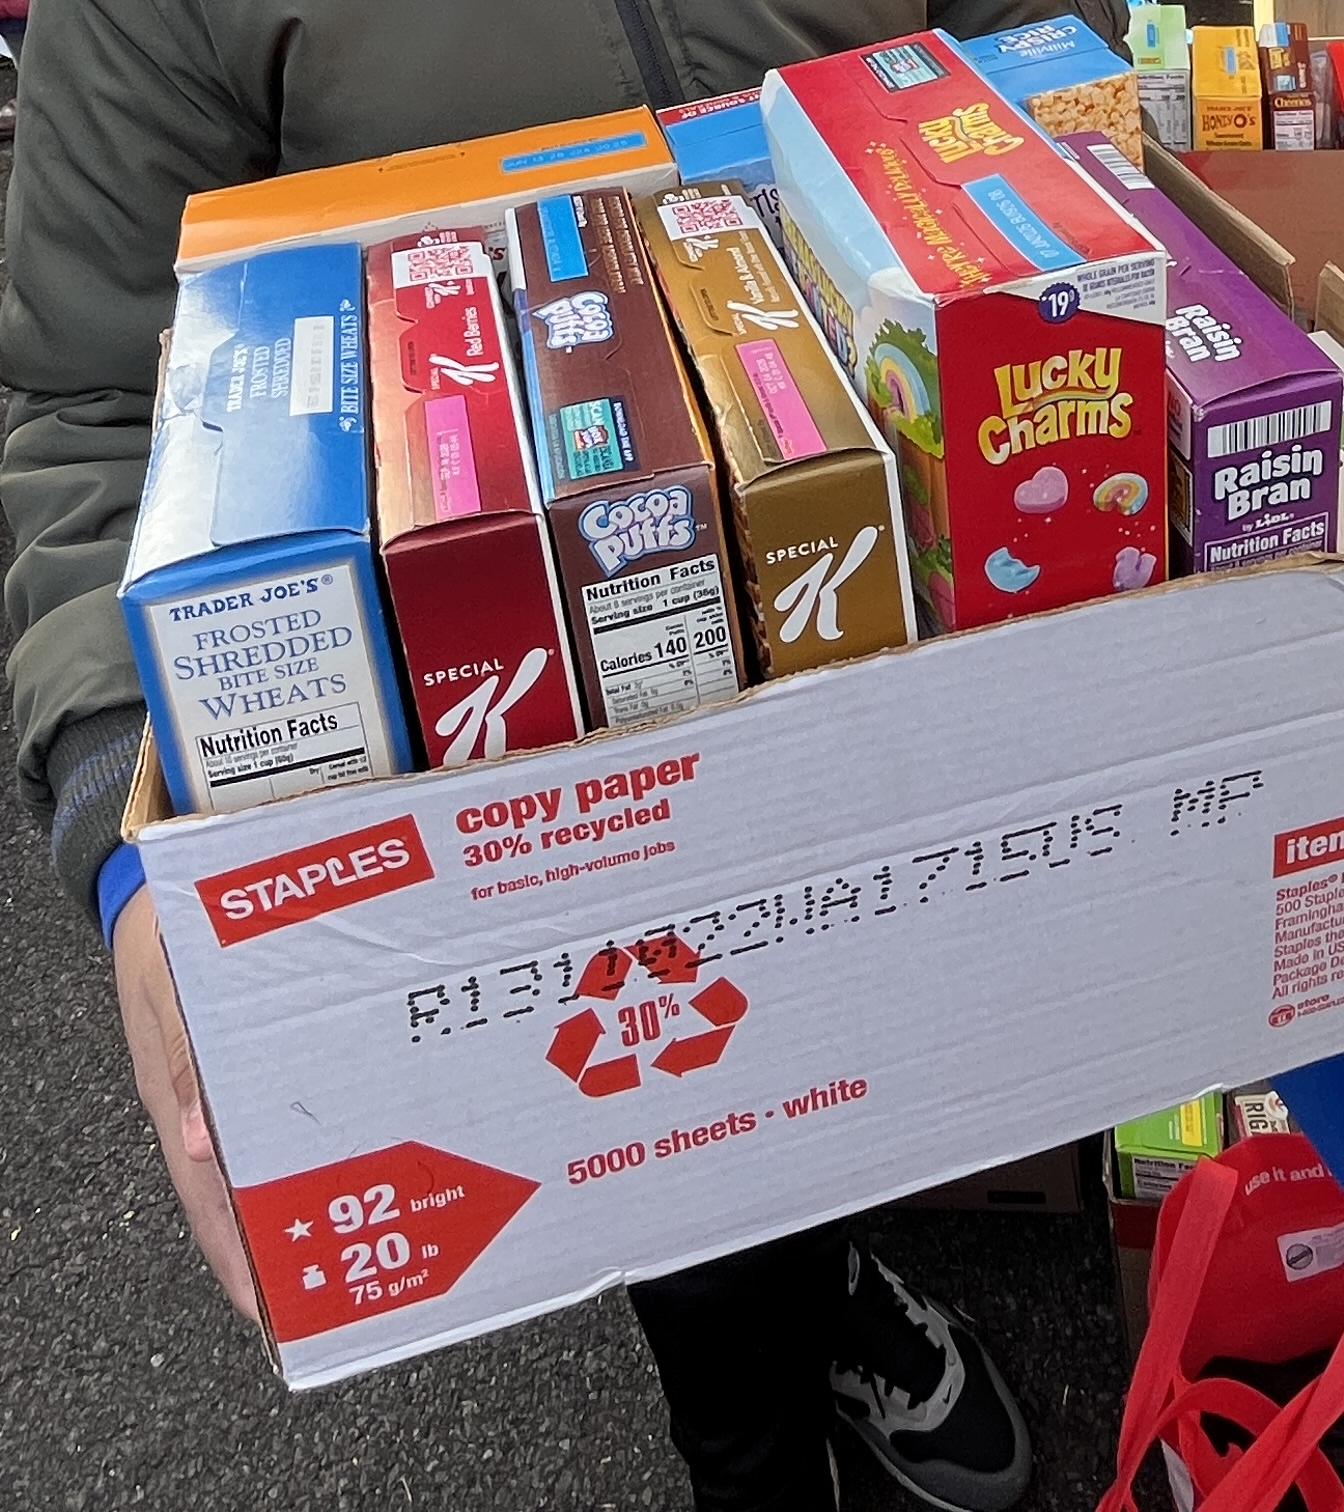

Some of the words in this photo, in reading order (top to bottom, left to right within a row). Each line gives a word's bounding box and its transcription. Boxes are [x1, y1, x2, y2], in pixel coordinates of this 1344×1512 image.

[997, 24, 1056, 45] RICE
[997, 27, 1078, 54] CRISPY
[1202, 114, 1233, 132] HONEY
[1274, 97, 1312, 108] Cheerios
[341, 314, 358, 360] WHEATS
[463, 306, 481, 336] Berries
[534, 298, 577, 346] Puffs
[572, 292, 610, 341] Cocoa
[1165, 315, 1211, 364] Bran
[1175, 303, 1243, 363] Raisin
[271, 338, 291, 398] SHREDDED
[466, 336, 484, 356] Red
[227, 375, 244, 412] TRADER
[250, 346, 270, 398] FROSTED
[341, 362, 359, 385] SIZE
[994, 347, 1122, 420] Lucky
[341, 388, 359, 414] BITE
[978, 392, 1134, 464] Charms
[1214, 444, 1324, 502] Raisin
[581, 488, 690, 539] Cocoa
[1228, 476, 1311, 523] Bran
[591, 516, 693, 577] Puffs
[766, 536, 839, 564] SPECIAL
[1209, 532, 1279, 565] Nutrition
[1282, 519, 1325, 544] Facts
[586, 573, 661, 601] Nutrition
[670, 559, 715, 581] Facts
[774, 526, 878, 643] K
[169, 593, 254, 622] TRADER
[193, 609, 321, 651] FROSTED
[591, 610, 630, 625] Serving
[633, 603, 653, 617] size
[663, 598, 668, 608] 1
[672, 594, 690, 608] cup
[173, 626, 352, 680] SHREDDED
[423, 657, 504, 687] SPECIAL
[600, 650, 652, 673] Calories
[655, 636, 687, 660] 140
[694, 626, 727, 649] 200
[199, 674, 347, 721] WHEATS
[219, 669, 269, 691] BITE
[275, 658, 320, 680] SIZE
[435, 647, 548, 766] K
[200, 726, 283, 758] Nutrition
[286, 713, 338, 740] Facts
[208, 765, 236, 779] Serving
[237, 762, 252, 774] size
[259, 758, 273, 771] cup
[456, 785, 563, 838] copy
[575, 752, 701, 812] paper
[463, 827, 533, 868] 30%
[541, 799, 671, 849] recycled
[220, 836, 411, 921] STAPLES
[471, 882, 495, 901] for
[497, 871, 544, 894] basic,
[545, 850, 640, 885] high-volume
[643, 838, 675, 861] jobs
[1276, 899, 1301, 917] 500
[1274, 935, 1322, 959] Staples
[1325, 925, 1344, 944] the
[1274, 952, 1310, 973] Made
[1312, 946, 1325, 961] in
[1272, 984, 1289, 1000] All
[1291, 973, 1328, 996] rights
[1273, 960, 1328, 988] Package
[617, 992, 681, 1048] 30%
[566, 1142, 645, 1186] 5000
[653, 1107, 756, 1160] sheets
[782, 1076, 868, 1120] white
[1244, 1171, 1270, 1196] use
[1272, 1166, 1287, 1182] it
[1290, 1163, 1324, 1182] and
[327, 1184, 401, 1235] 92
[410, 1185, 466, 1214] bright
[341, 1231, 411, 1284] 20
[421, 1241, 440, 1260] lb
[349, 1279, 383, 1306] 75
